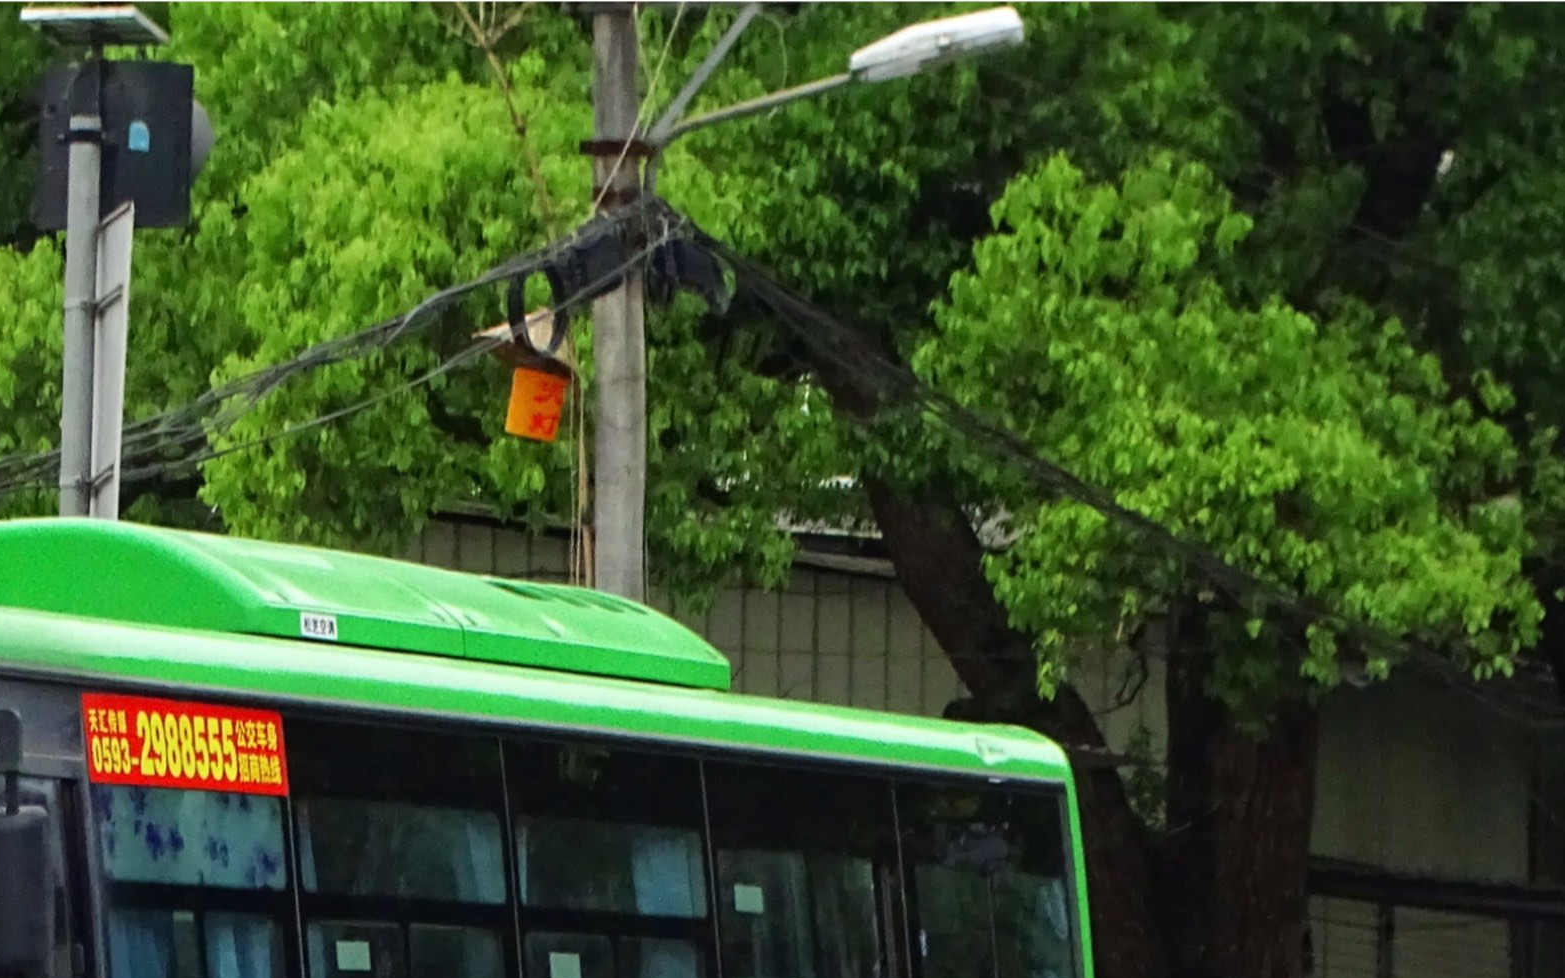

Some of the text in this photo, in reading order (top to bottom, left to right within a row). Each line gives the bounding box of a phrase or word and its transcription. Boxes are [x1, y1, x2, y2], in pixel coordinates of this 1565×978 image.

[235, 719, 278, 751] 公交车身
[238, 753, 283, 785] 招商热线
